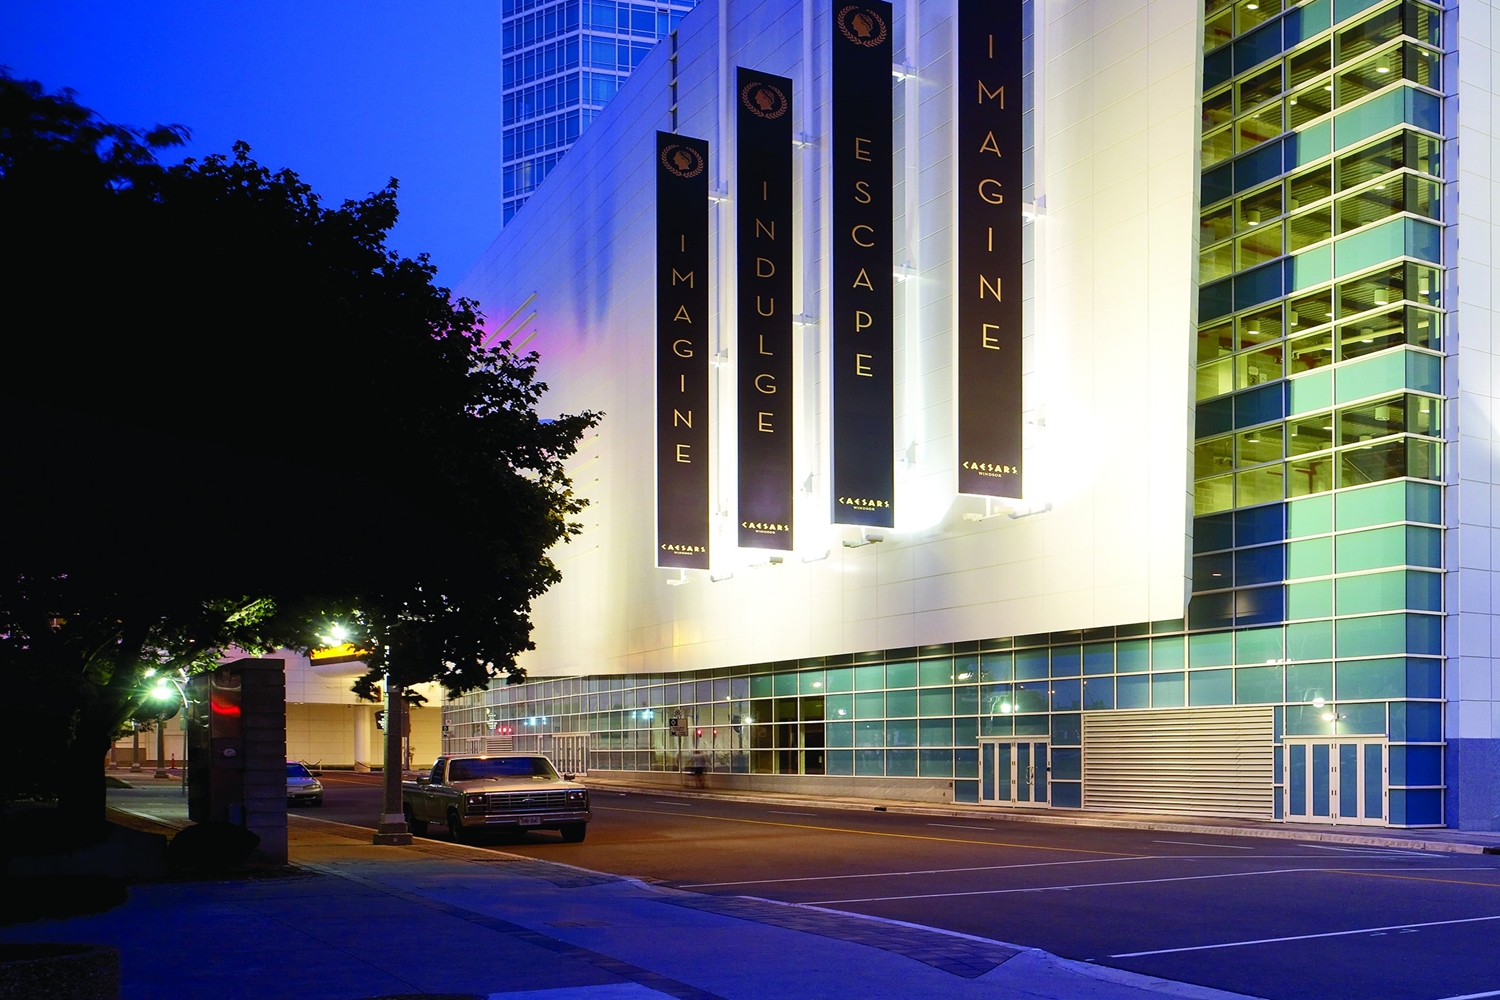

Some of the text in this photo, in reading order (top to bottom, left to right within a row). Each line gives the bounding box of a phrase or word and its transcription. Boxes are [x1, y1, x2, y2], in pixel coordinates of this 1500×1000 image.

[978, 34, 1005, 350] IMAGINE
[754, 181, 776, 433] INDULGE
[851, 137, 874, 377] ESCAPE
[672, 234, 694, 463] IMAGINE
[741, 521, 789, 532] CAESARS
[838, 496, 890, 508] CAESARS
[962, 461, 1017, 474] CAESARS
[661, 543, 705, 553] CAESARS
